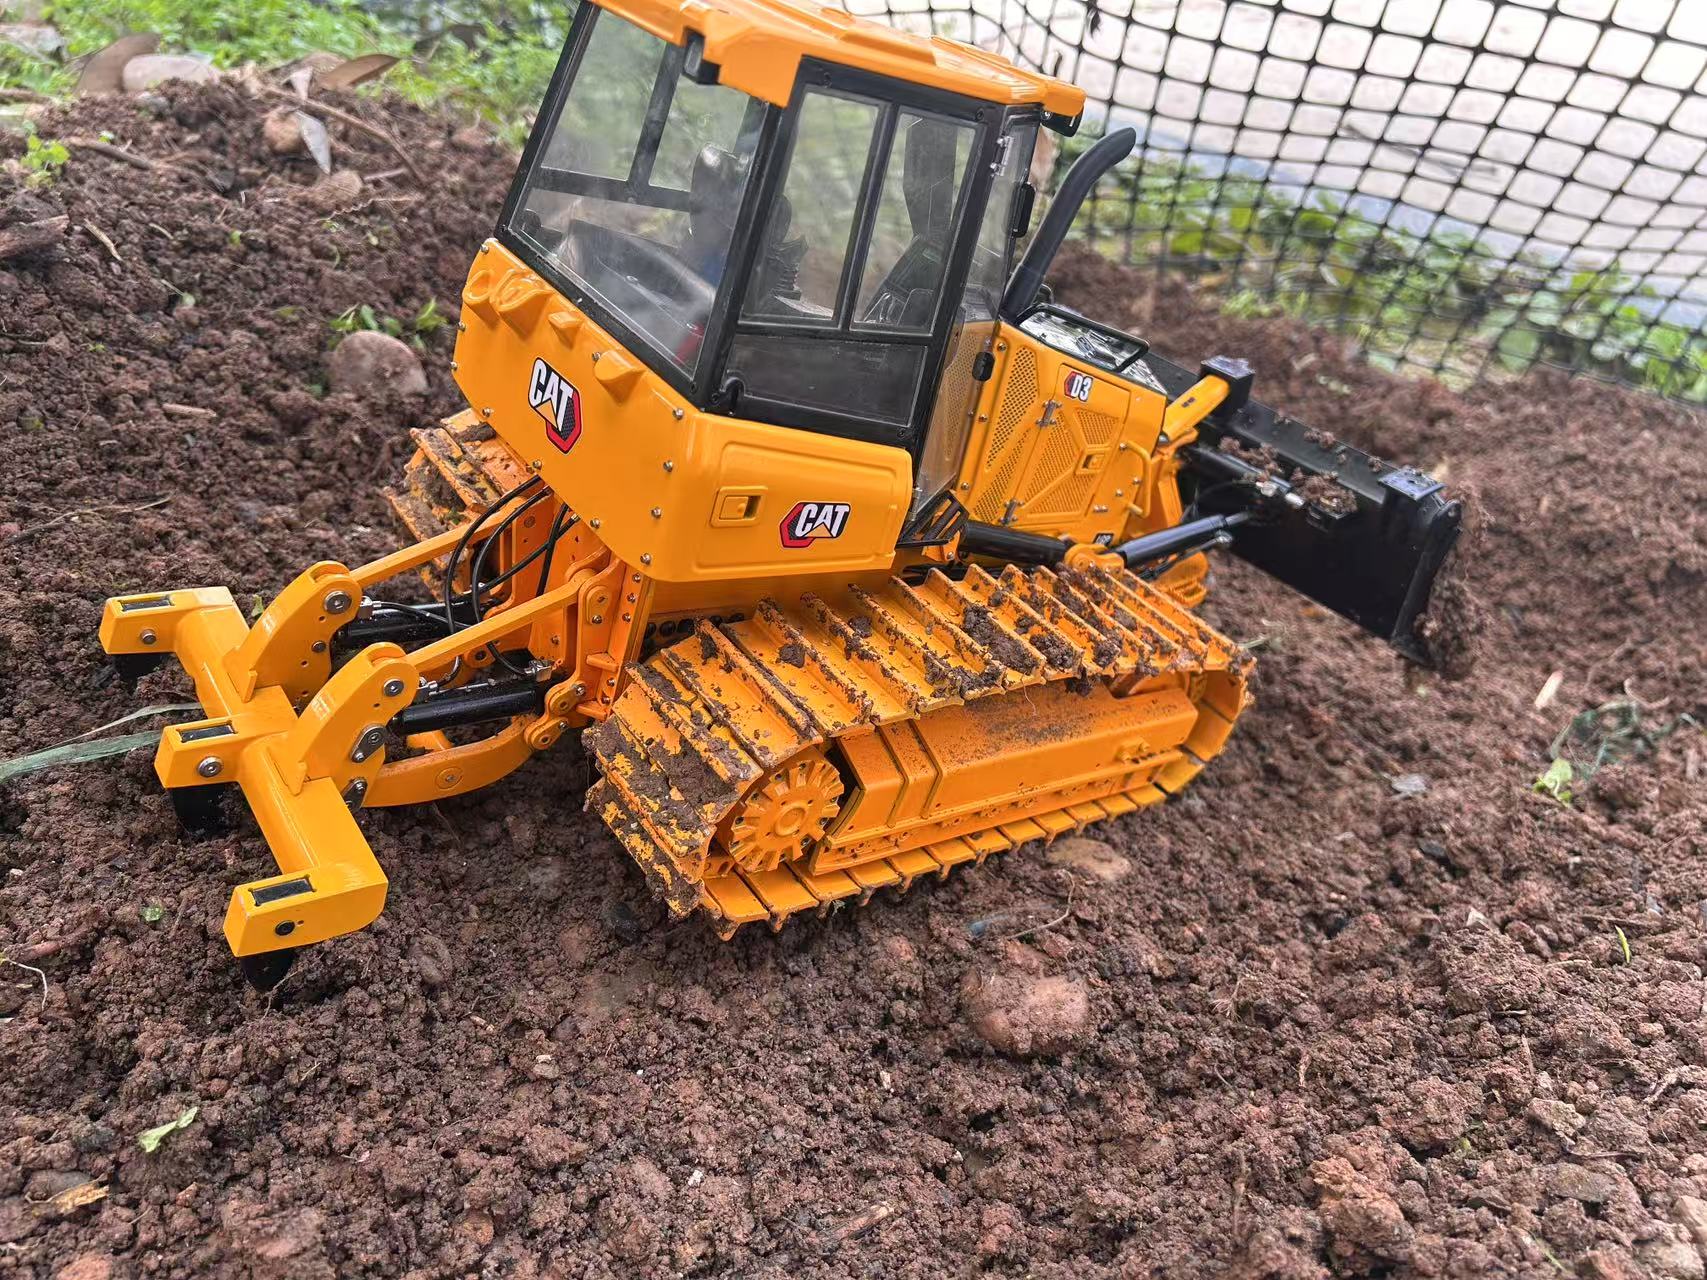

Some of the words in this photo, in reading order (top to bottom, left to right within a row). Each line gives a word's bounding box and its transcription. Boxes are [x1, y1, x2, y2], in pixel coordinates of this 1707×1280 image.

[528, 358, 574, 432] CAT
[1070, 374, 1092, 401] D3
[795, 503, 849, 537] CAT
